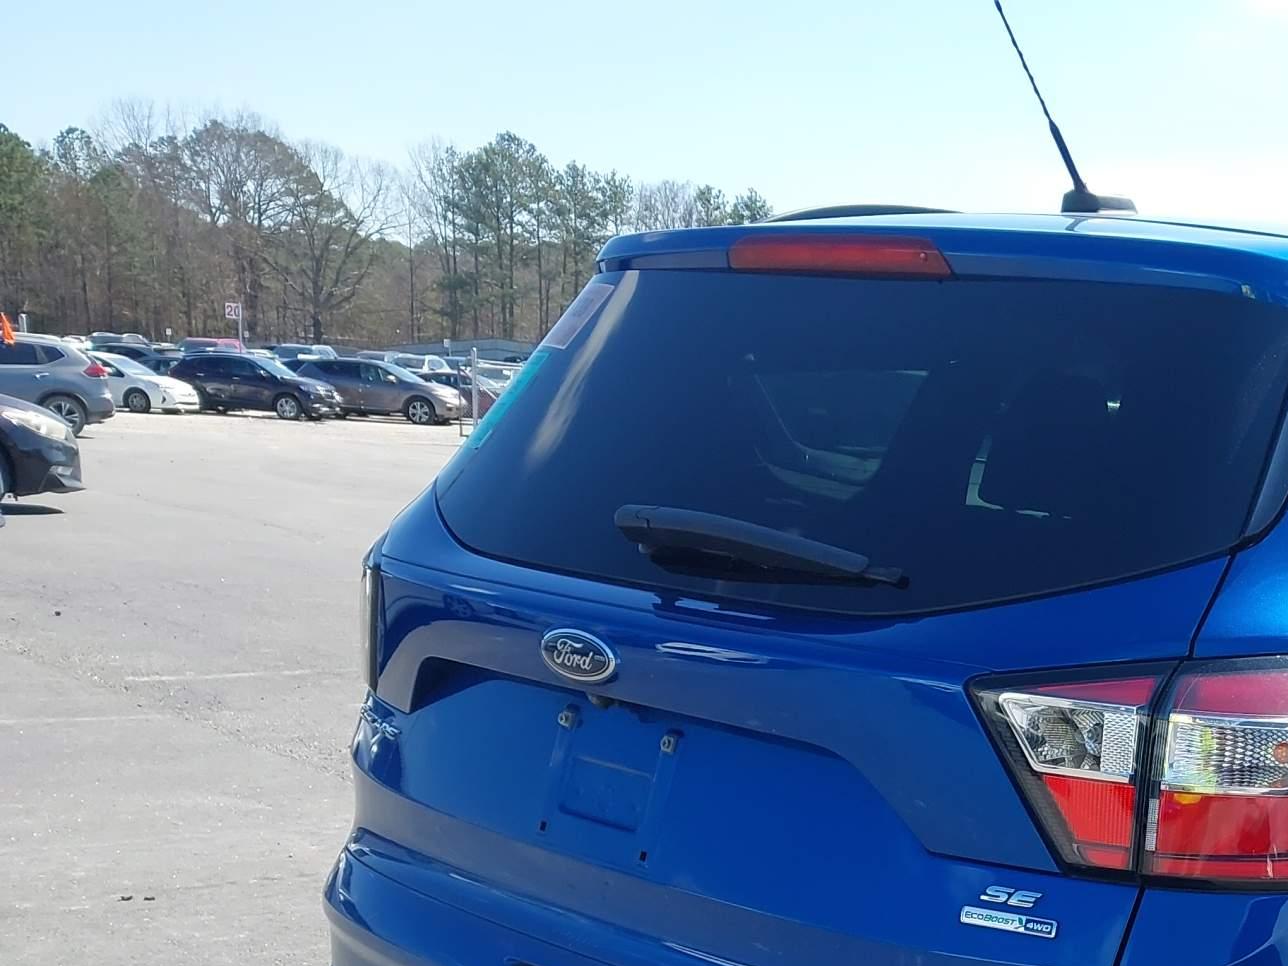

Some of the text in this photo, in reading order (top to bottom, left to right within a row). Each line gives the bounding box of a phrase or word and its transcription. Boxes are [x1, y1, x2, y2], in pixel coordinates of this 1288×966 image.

[553, 638, 594, 671] Ford
[979, 885, 1043, 908] SE
[1025, 921, 1052, 932] 4WD
